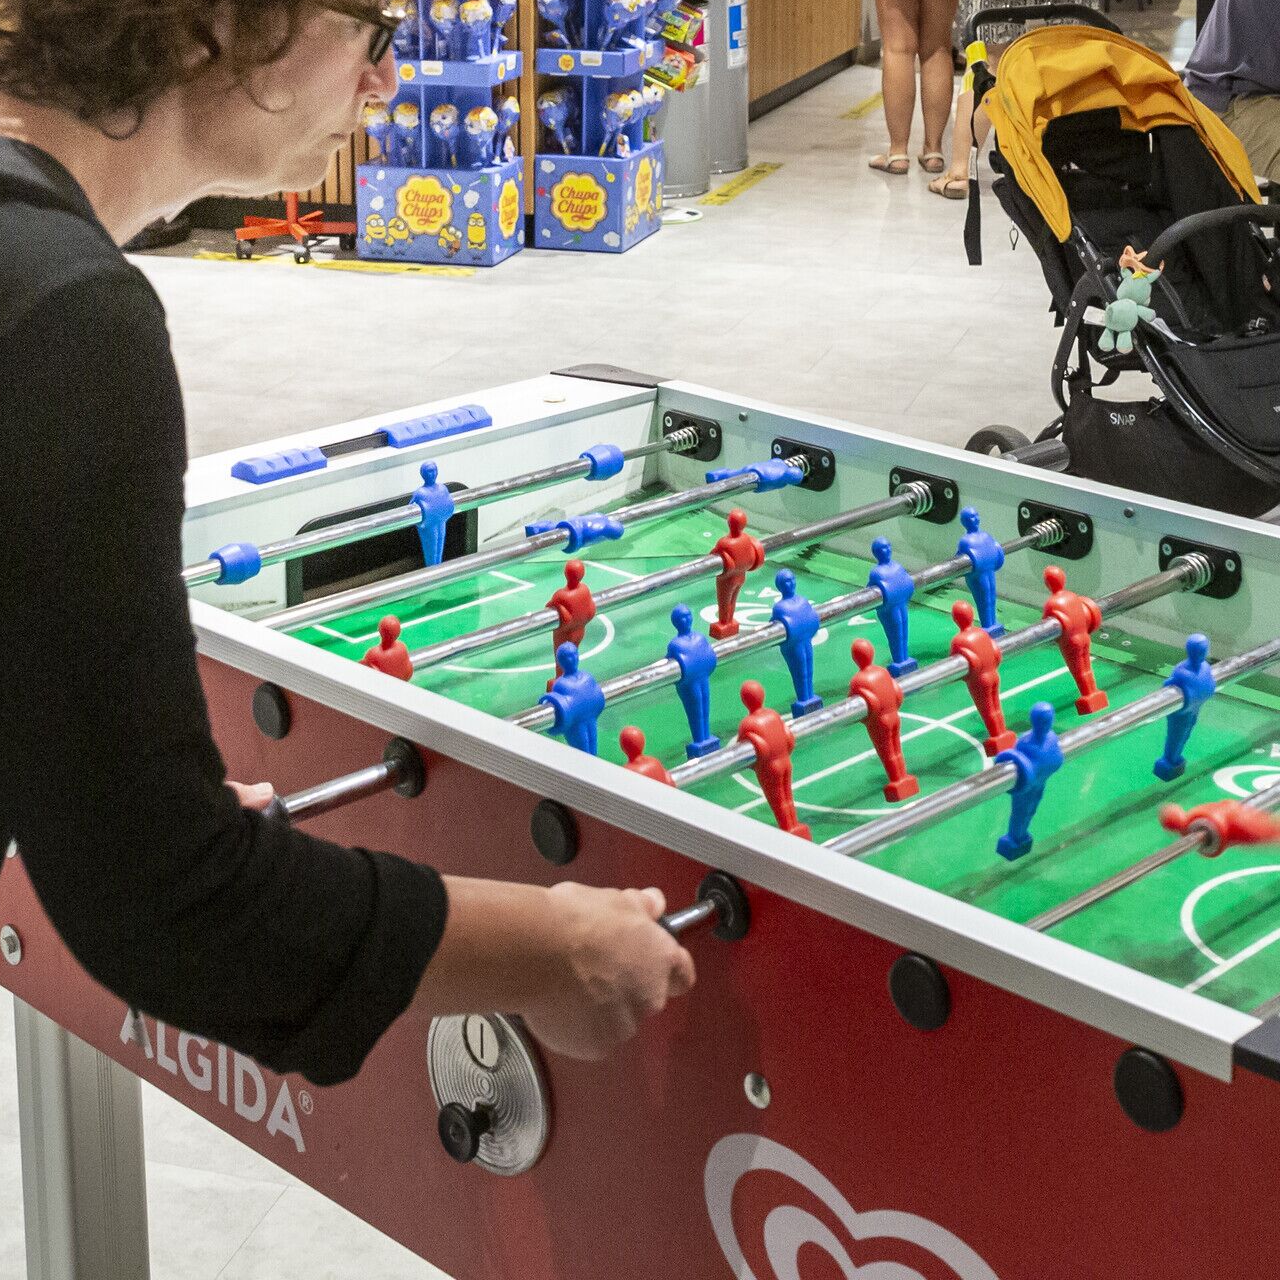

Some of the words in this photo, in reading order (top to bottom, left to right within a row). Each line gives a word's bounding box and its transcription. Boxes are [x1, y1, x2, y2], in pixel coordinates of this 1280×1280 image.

[405, 188, 445, 206] Chupa
[560, 186, 600, 203] Chupa
[403, 203, 443, 221] Chups
[558, 200, 598, 218] Chups
[1110, 412, 1136, 425] SNAP
